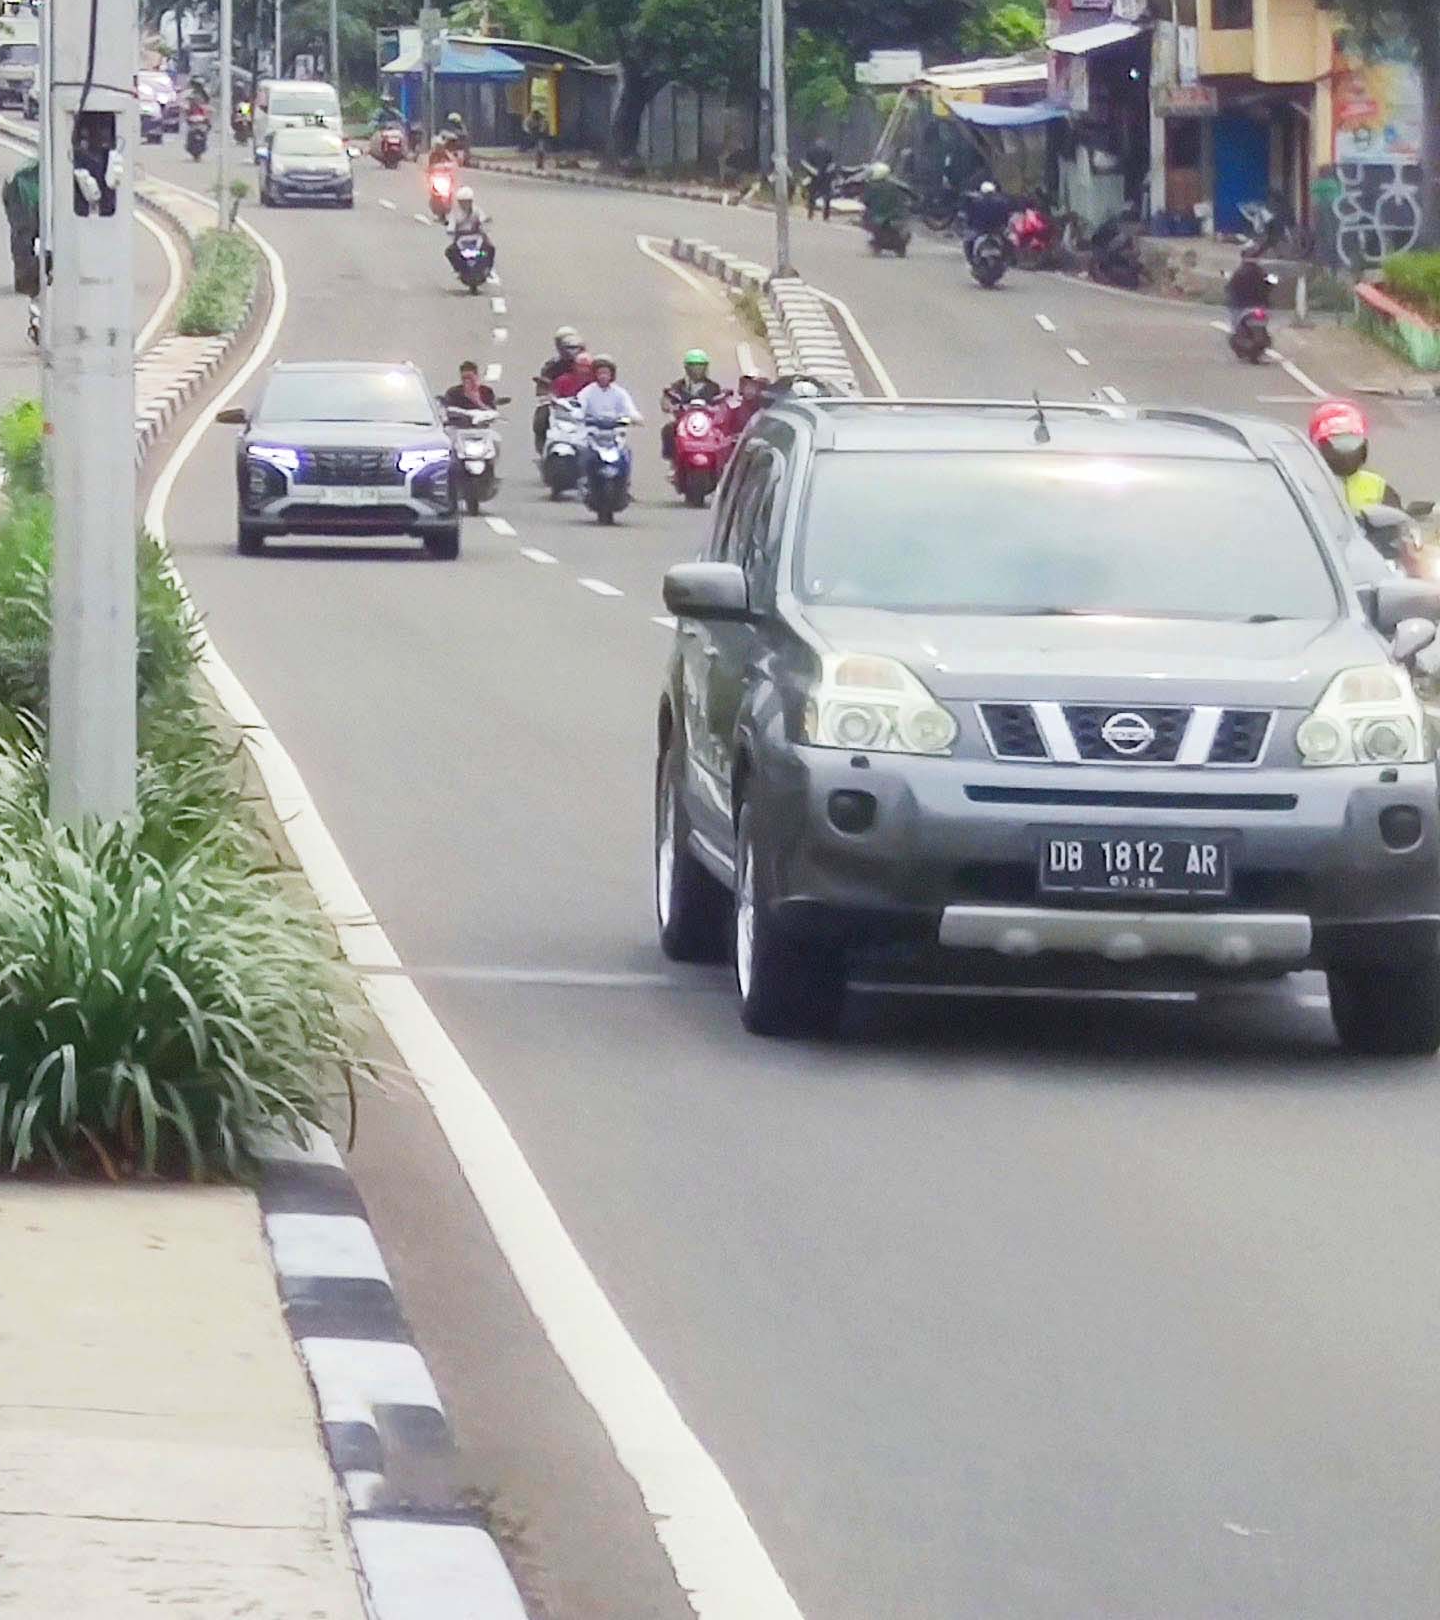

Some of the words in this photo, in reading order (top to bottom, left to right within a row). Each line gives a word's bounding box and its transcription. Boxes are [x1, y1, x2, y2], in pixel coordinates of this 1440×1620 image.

[1049, 840, 1083, 873] DB
[1100, 840, 1164, 874] 1812
[1185, 844, 1218, 877] AR
